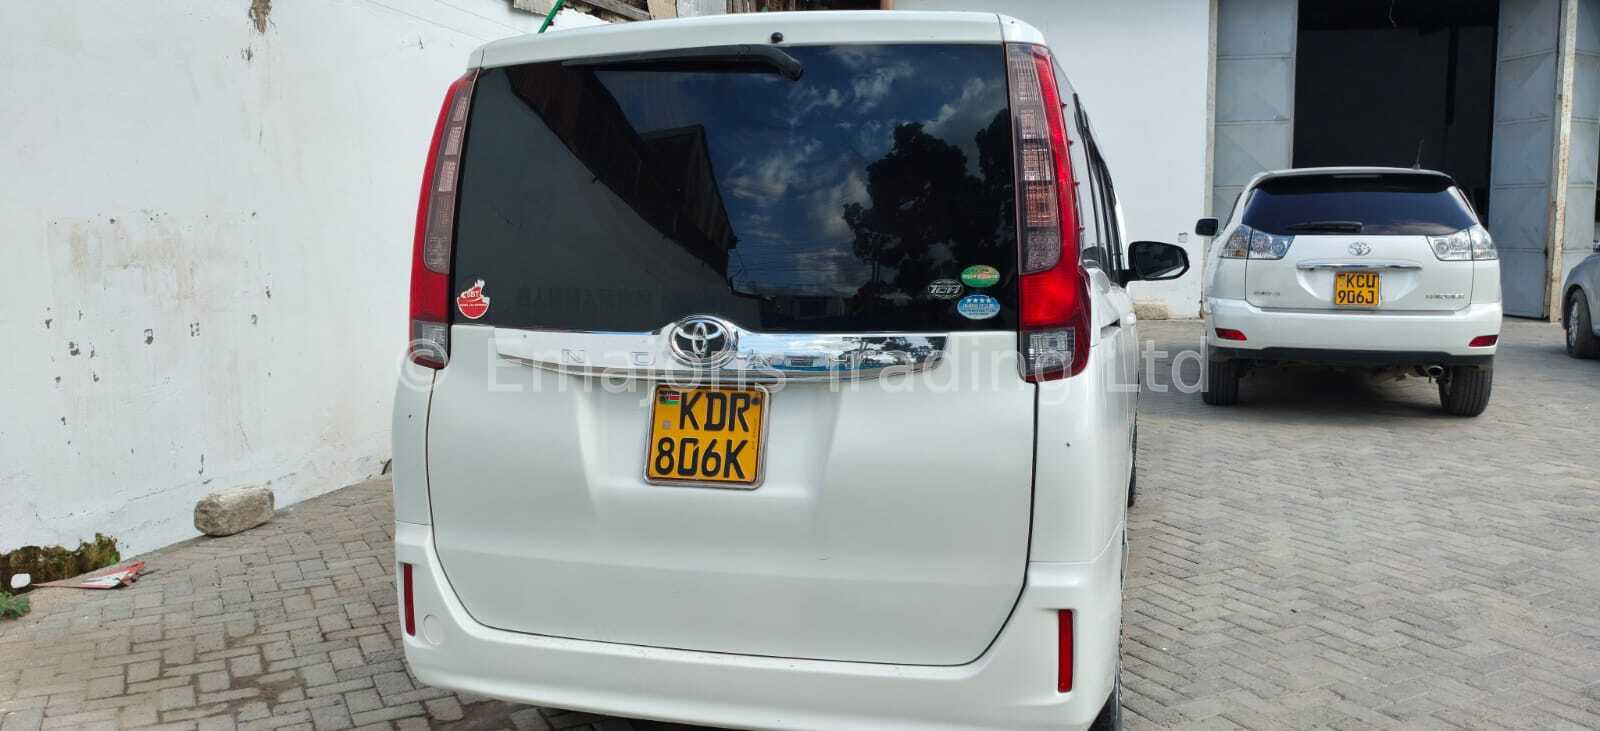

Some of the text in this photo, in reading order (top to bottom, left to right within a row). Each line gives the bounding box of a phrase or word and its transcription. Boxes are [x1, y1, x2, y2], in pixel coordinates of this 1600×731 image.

[1346, 274, 1376, 289] KCU
[1337, 290, 1374, 304] 906J
[680, 391, 751, 432] KDR
[655, 437, 748, 479] 806K
